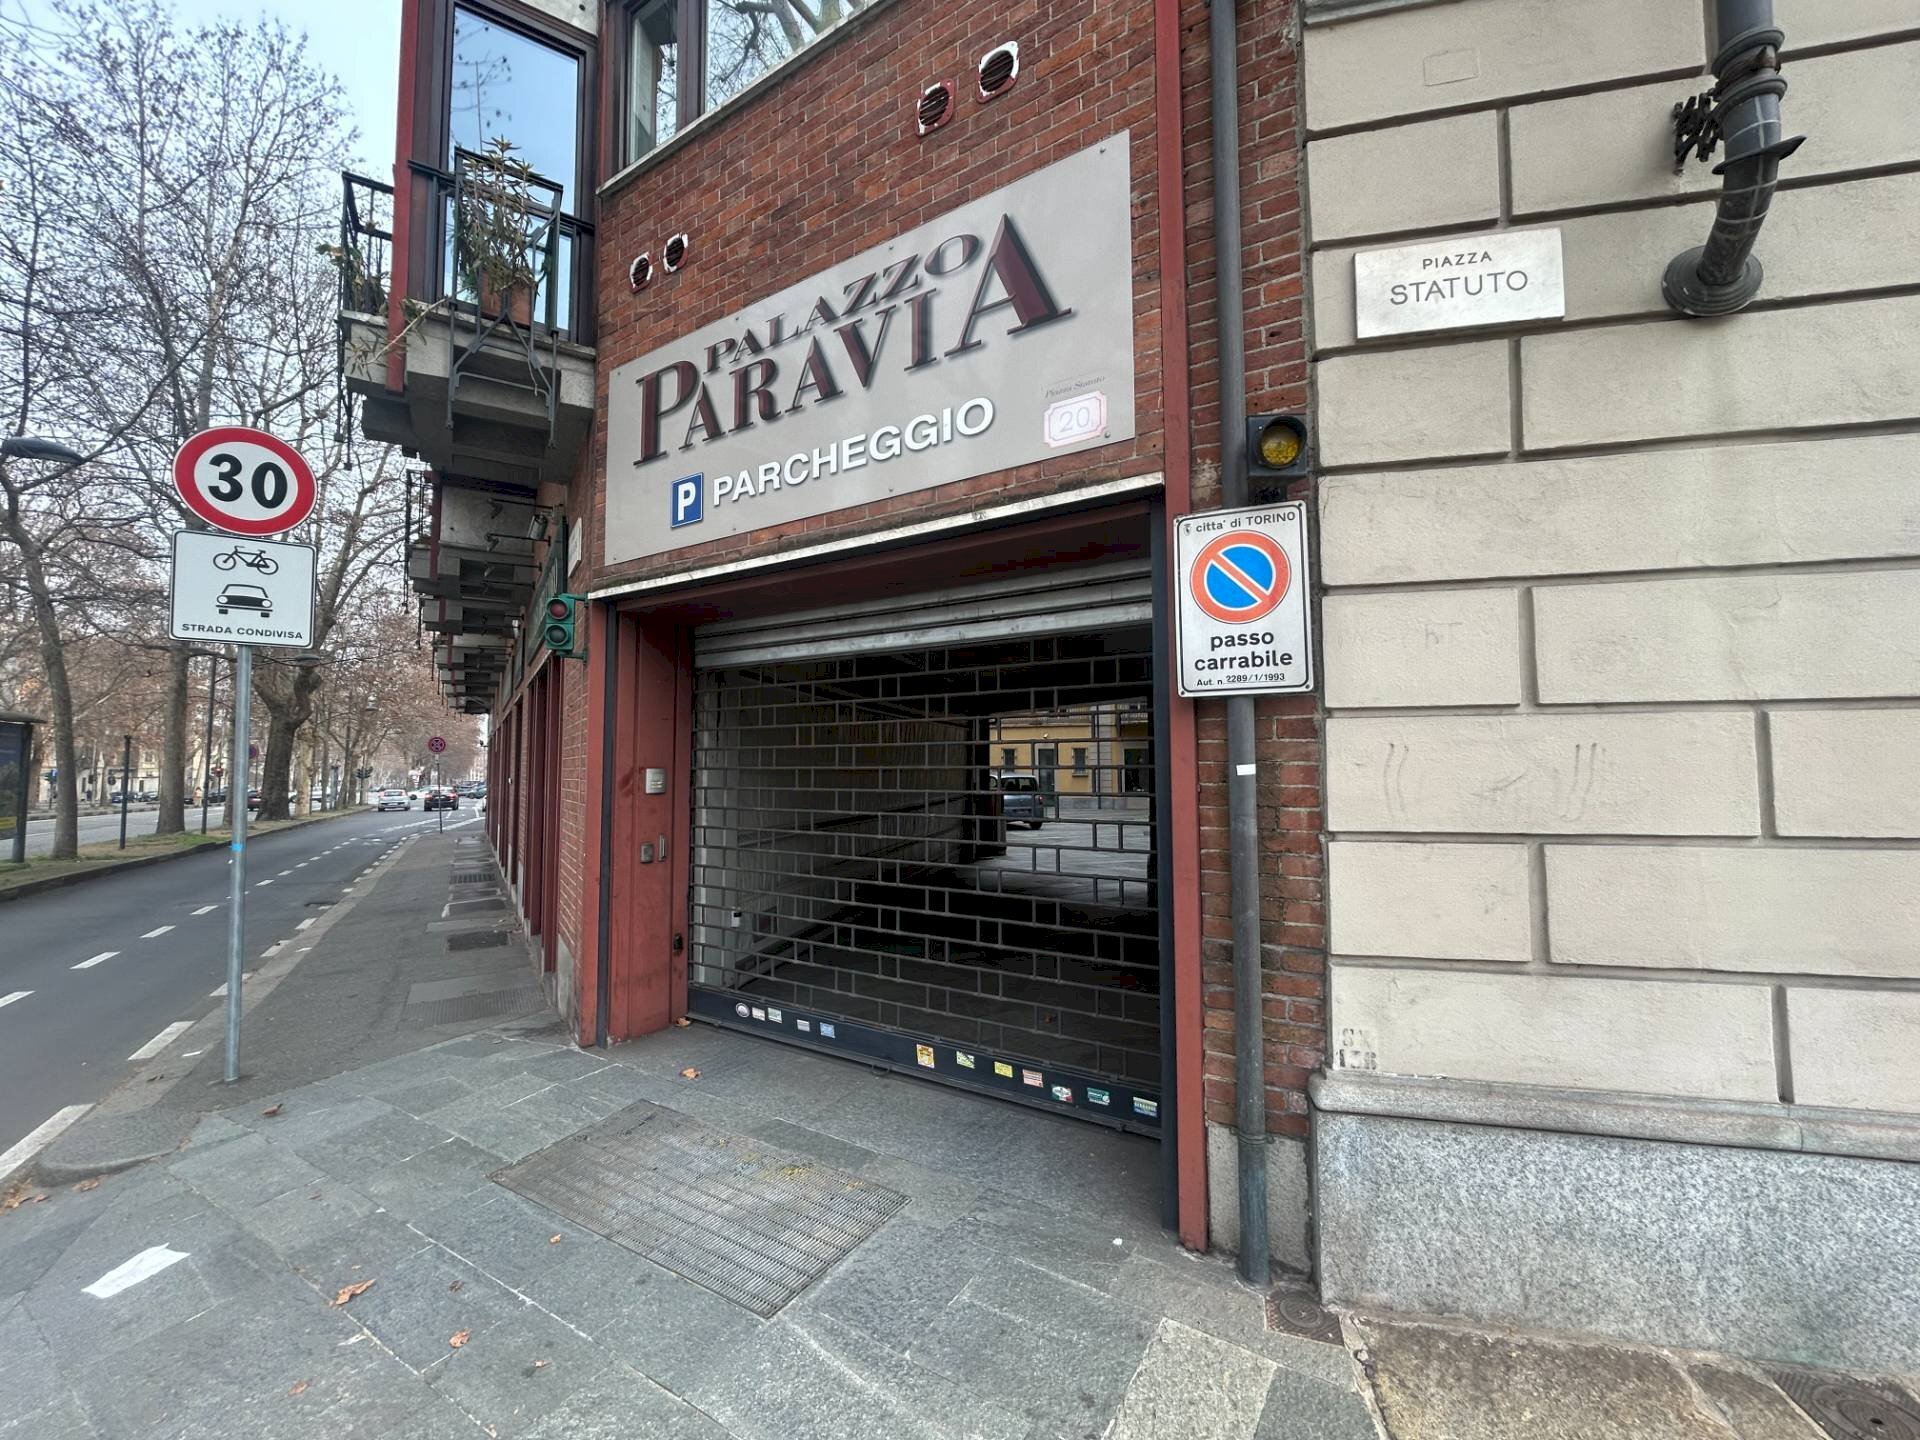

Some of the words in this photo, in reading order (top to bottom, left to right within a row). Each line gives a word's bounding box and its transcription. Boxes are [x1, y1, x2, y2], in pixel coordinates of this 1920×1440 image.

[1422, 251, 1492, 270] PIAZZA
[1390, 270, 1528, 306] STATUTO
[703, 232, 981, 375] PALAZZO
[633, 212, 1073, 467] PARAVIA
[1058, 406, 1090, 433] 20
[676, 481, 697, 522] P
[712, 396, 996, 508] PARCHEGGIO
[207, 453, 289, 509] 30
[1230, 518, 1241, 528] di
[1246, 511, 1296, 526] TORINO
[181, 623, 232, 635] STRADA
[236, 627, 303, 640] CONDIVISA
[1210, 631, 1275, 652] passo
[1194, 649, 1293, 672] carrabile
[1225, 672, 1286, 683] 2289/1/1993
